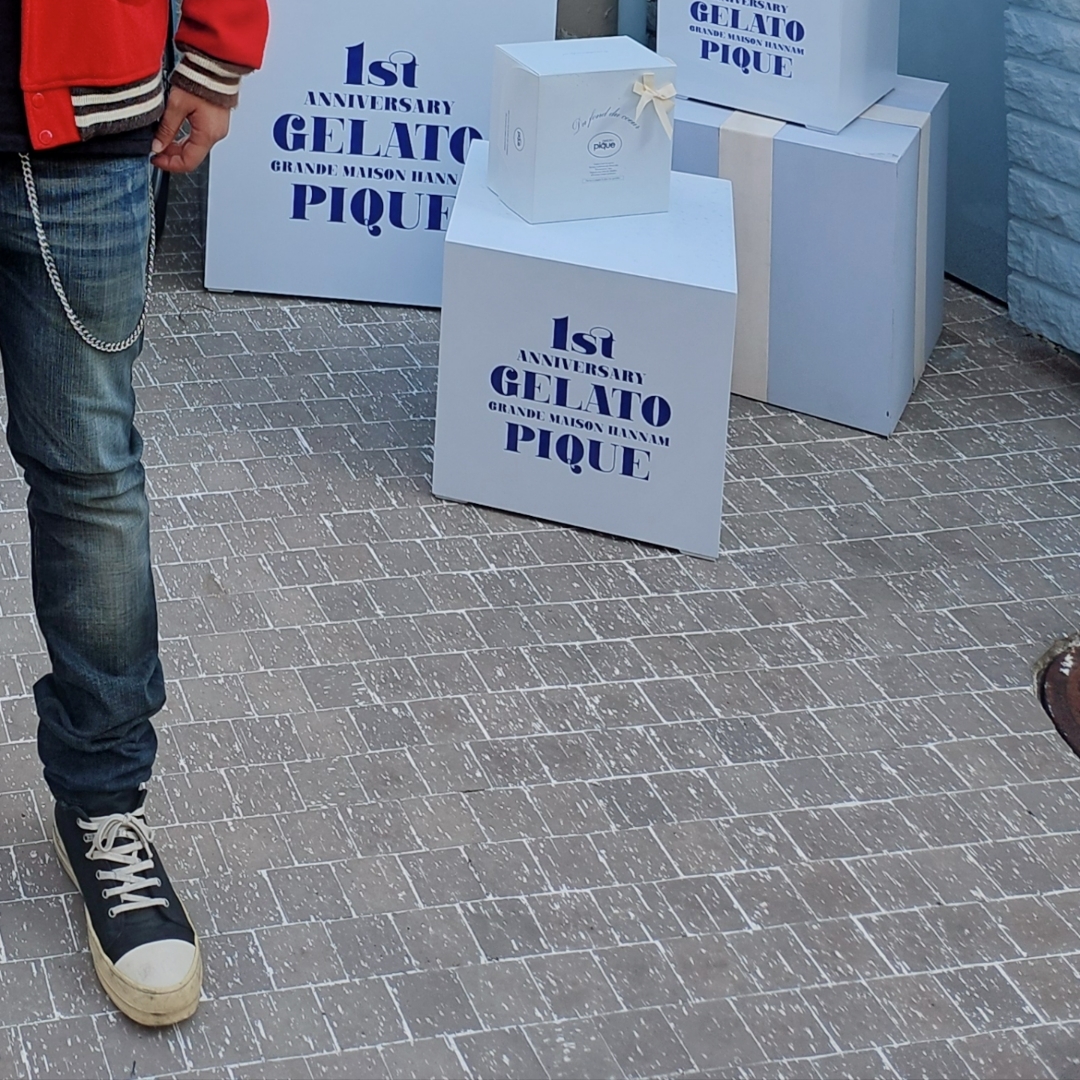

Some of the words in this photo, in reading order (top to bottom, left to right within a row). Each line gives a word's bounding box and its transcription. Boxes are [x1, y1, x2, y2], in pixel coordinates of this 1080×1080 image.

[689, 25, 726, 39] GRANDE
[727, 32, 763, 47] MAISON
[764, 40, 805, 56] HANNAM
[690, 0, 805, 43] GELATO
[343, 41, 419, 88] 1st
[700, 38, 793, 78] PIQUE
[304, 91, 455, 115] ANNIVERSARY
[272, 113, 483, 165] GELATO
[593, 141, 616, 151] pique
[270, 160, 338, 176] GRANDE
[342, 165, 406, 182] MAISON
[411, 171, 461, 186] HANN
[550, 316, 616, 360] 1st
[517, 349, 646, 386] ANNIVERSARY
[490, 364, 672, 428] GELATO
[488, 400, 545, 421] GRANDE
[549, 413, 604, 433] MAISON
[608, 425, 670, 448] HANNAM
[504, 421, 651, 481] PIQUE
